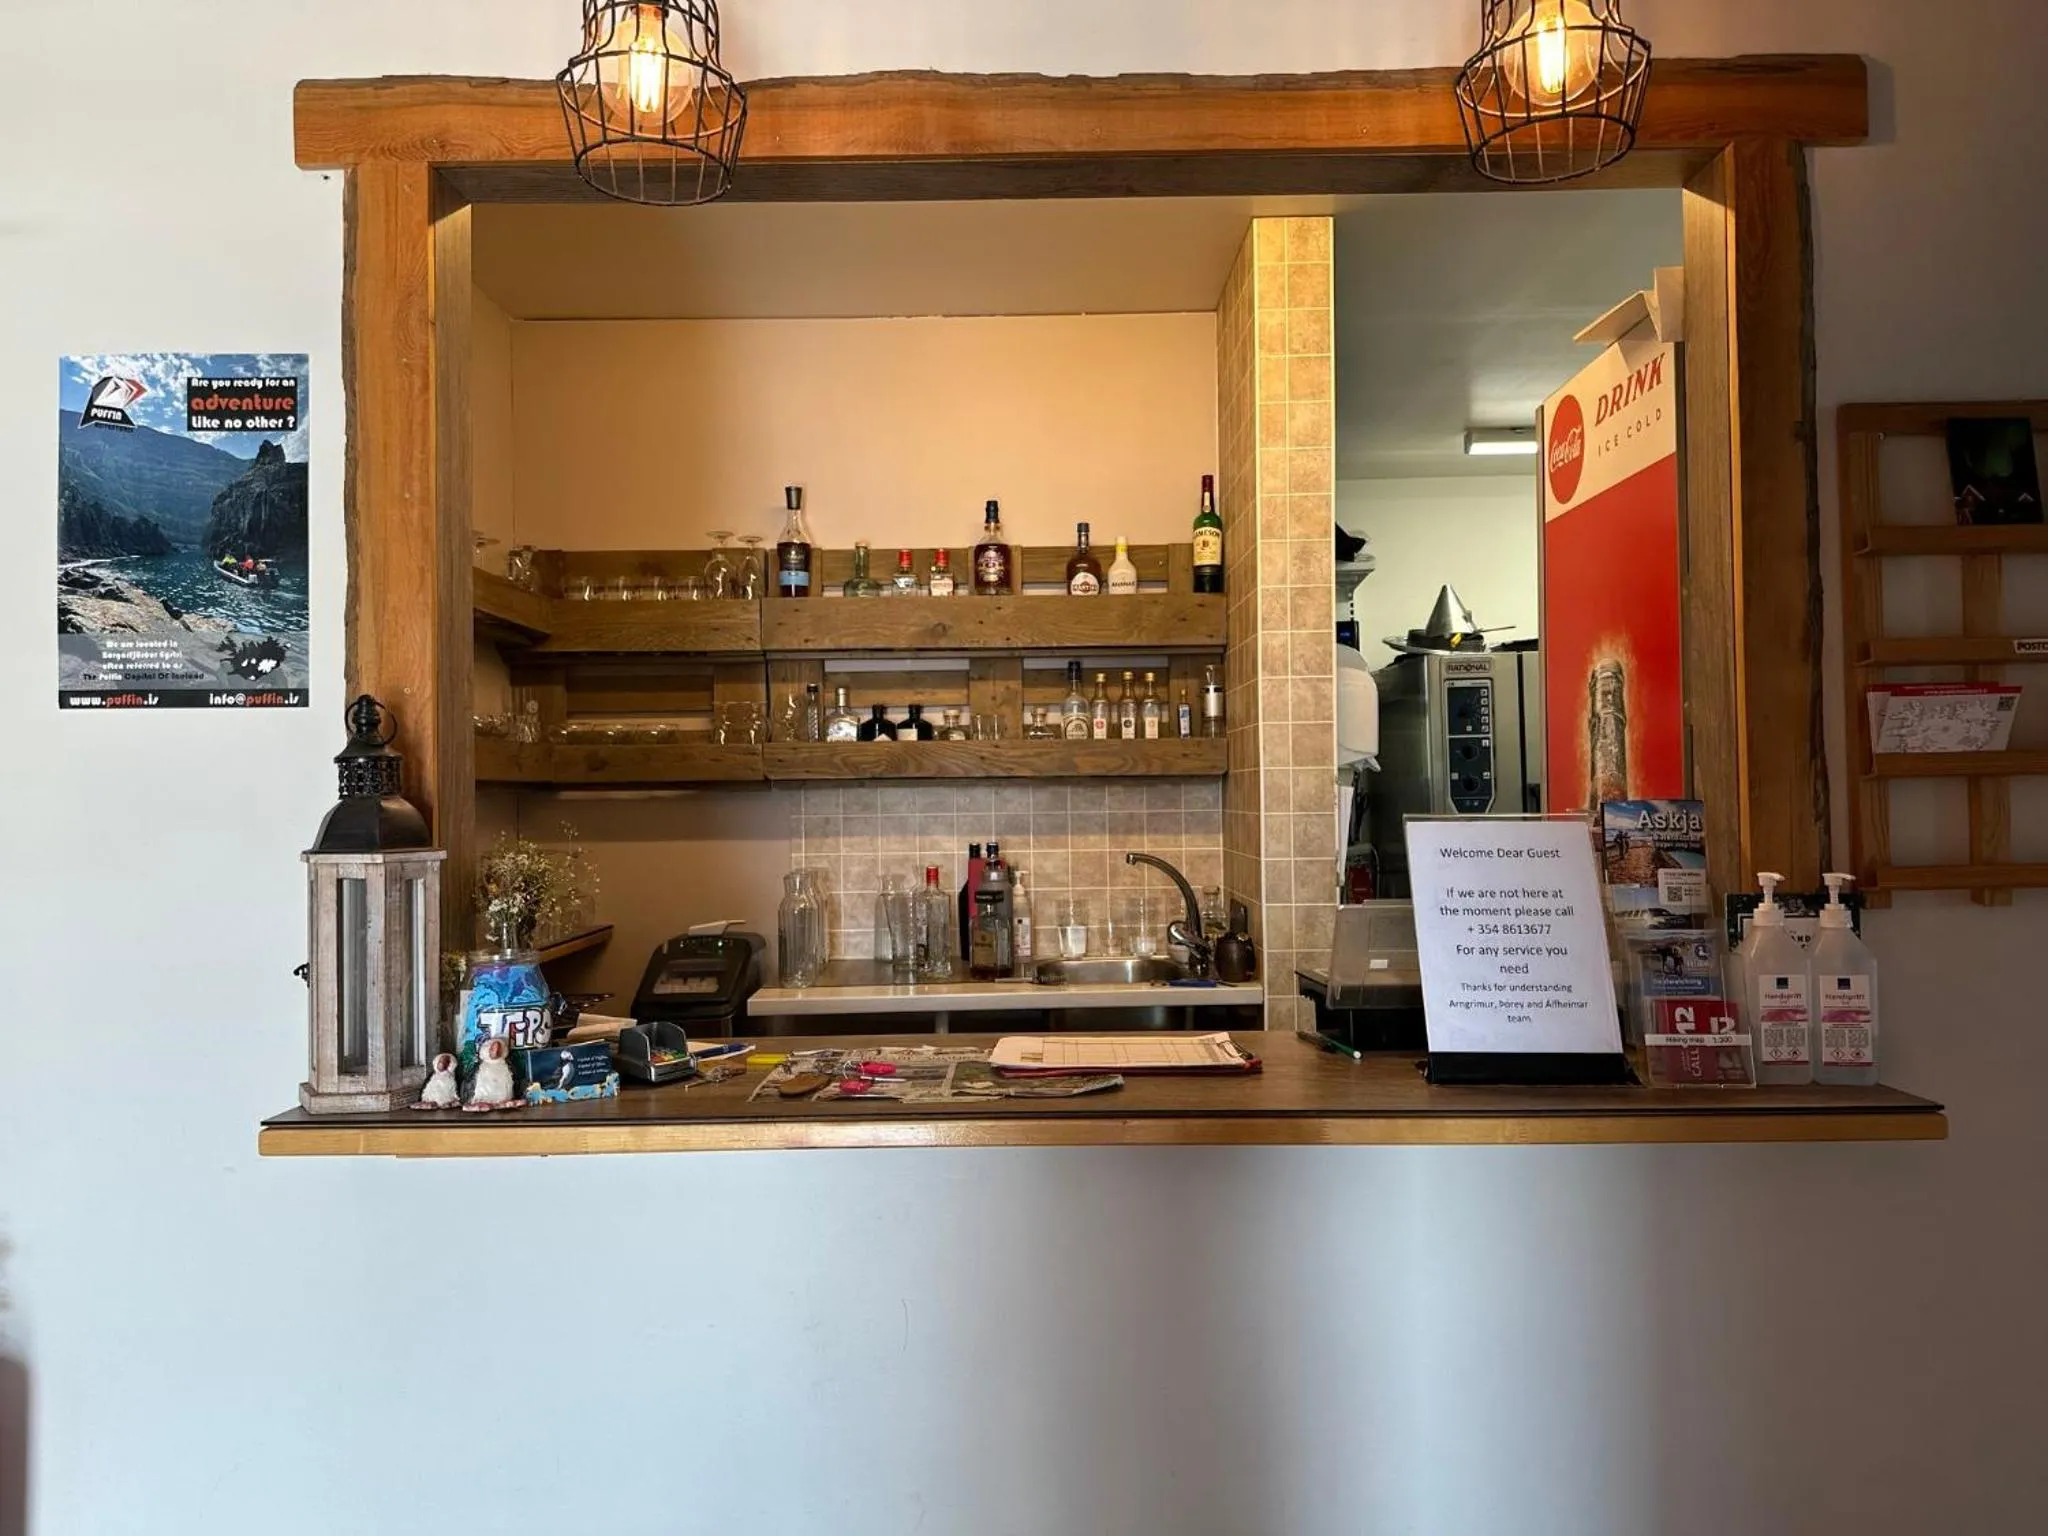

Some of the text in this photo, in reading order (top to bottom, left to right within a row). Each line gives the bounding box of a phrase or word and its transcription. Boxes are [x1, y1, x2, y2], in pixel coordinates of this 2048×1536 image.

[191, 378, 295, 390] Are you ready for an
[1595, 352, 1666, 427] DRINK
[191, 393, 295, 411] adventure
[191, 416, 295, 428] Like no other ?
[1598, 408, 1662, 457] ICE COLD
[102, 662, 124, 670] often
[126, 662, 160, 670] referred
[162, 662, 171, 670] to
[69, 693, 159, 708] www.puffin.is
[209, 692, 299, 708] info@puffin.is
[1636, 808, 1702, 834] Askja
[1440, 848, 1561, 858] Welcome Dear Guest
[1446, 887, 1564, 898] If we are not here at
[1440, 905, 1574, 918] the moment please call
[1478, 924, 1499, 934] 354
[1502, 924, 1551, 934] 8613677
[1456, 944, 1568, 957] For any service you
[1499, 963, 1529, 974] need
[1460, 982, 1573, 993] Thanks for understanding
[1526, 1000, 1543, 1008] and
